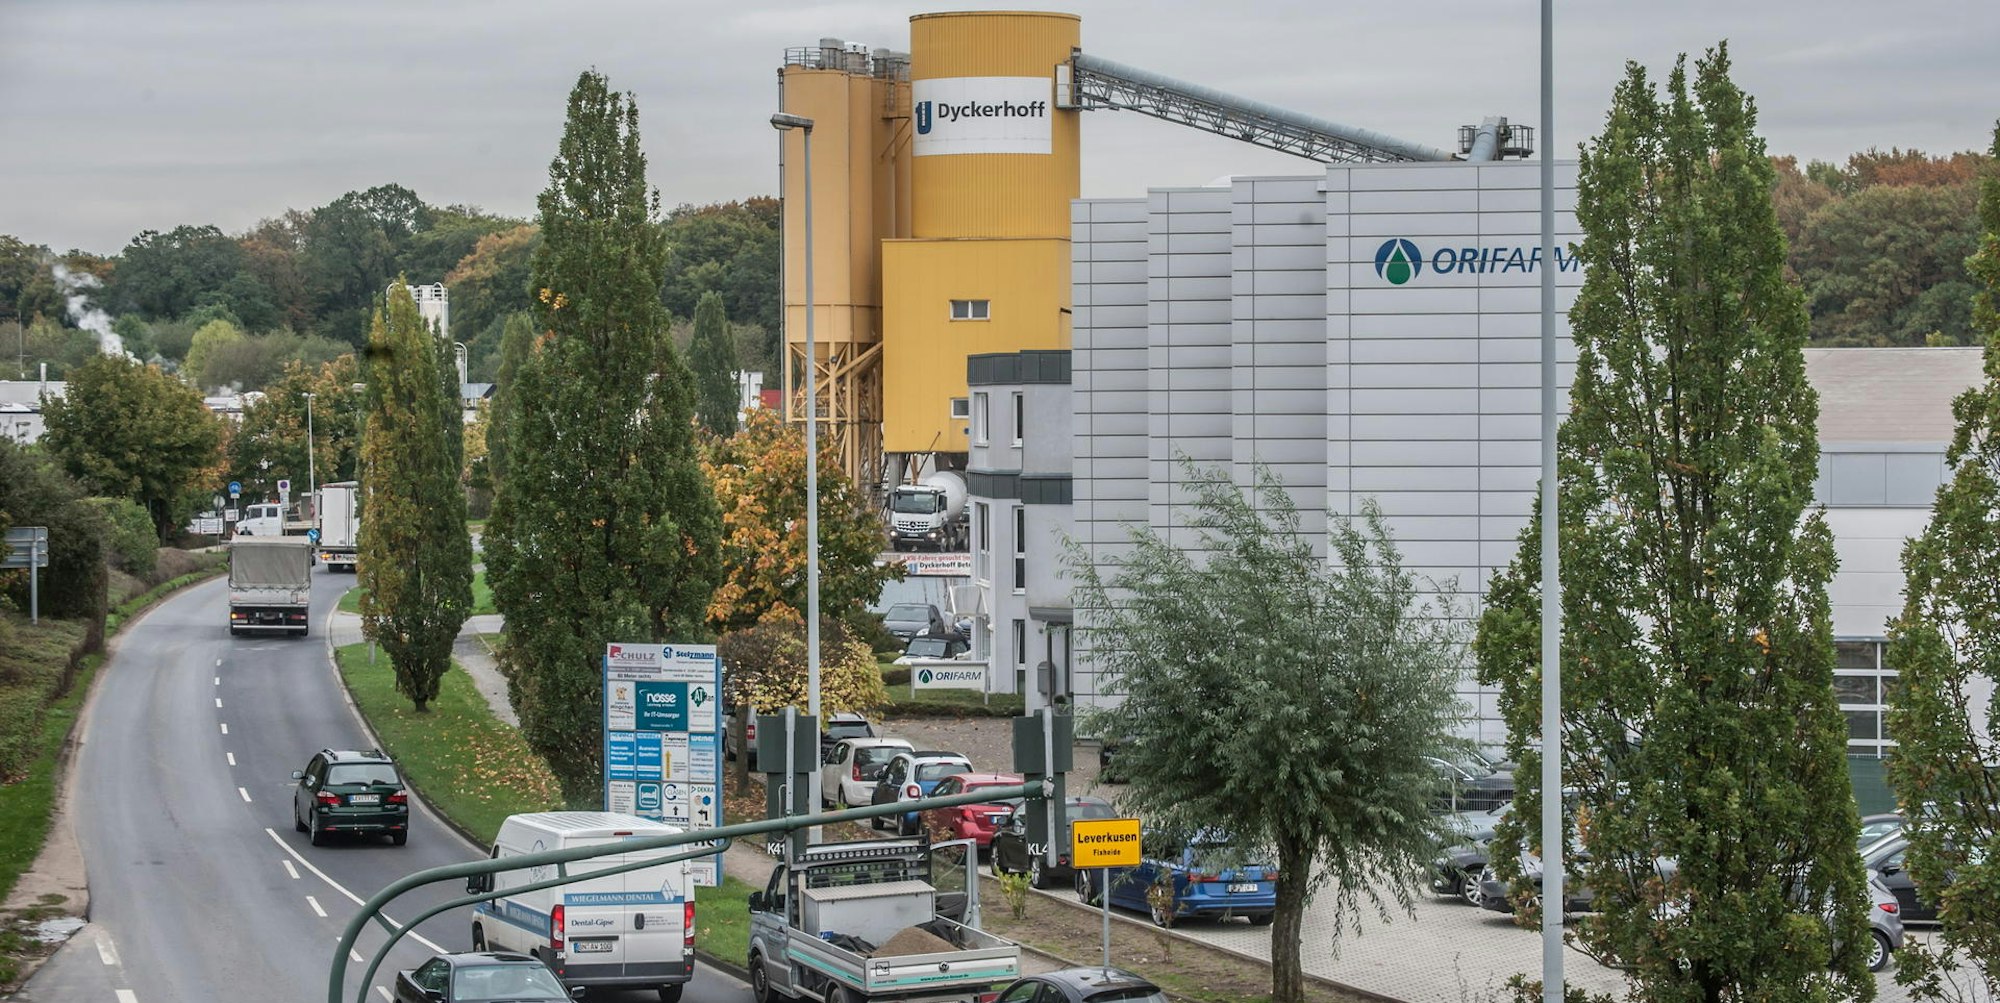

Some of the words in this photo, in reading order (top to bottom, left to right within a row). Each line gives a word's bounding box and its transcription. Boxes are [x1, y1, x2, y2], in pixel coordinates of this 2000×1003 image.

[938, 101, 1046, 122] Dyckerhoff
[935, 671, 982, 681] ORIFARM
[1077, 832, 1137, 843] Leverkusen
[767, 842, 786, 855] K41
[571, 894, 625, 903] WIEGELMANN
[625, 893, 655, 901] DENTAL
[571, 918, 615, 927] Dental-Gipse
